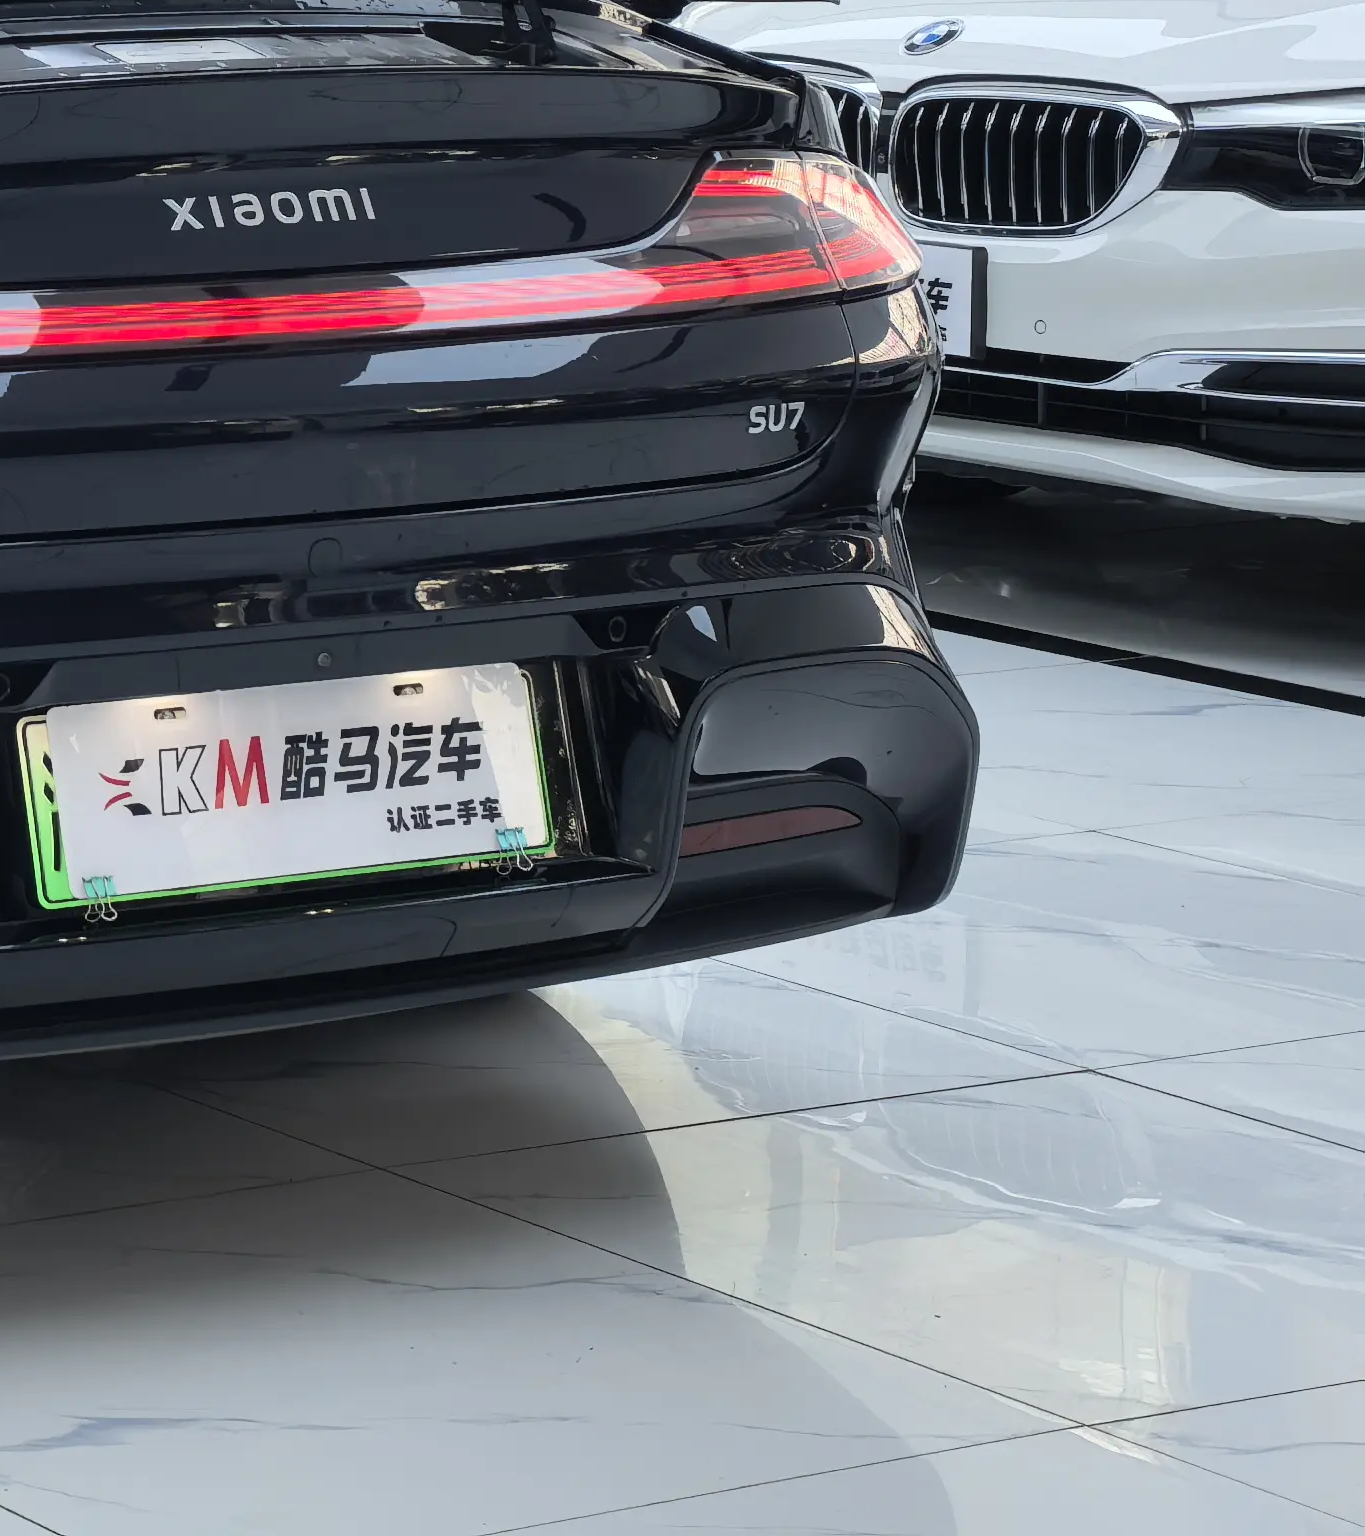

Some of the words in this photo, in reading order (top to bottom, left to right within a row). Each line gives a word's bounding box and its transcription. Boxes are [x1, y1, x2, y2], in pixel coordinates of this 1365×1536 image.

[919, 277, 953, 315] 车
[748, 401, 805, 434] SU7
[158, 736, 270, 816] KM
[280, 717, 483, 801] 酷马汽车
[386, 797, 503, 833] 认证二手车
